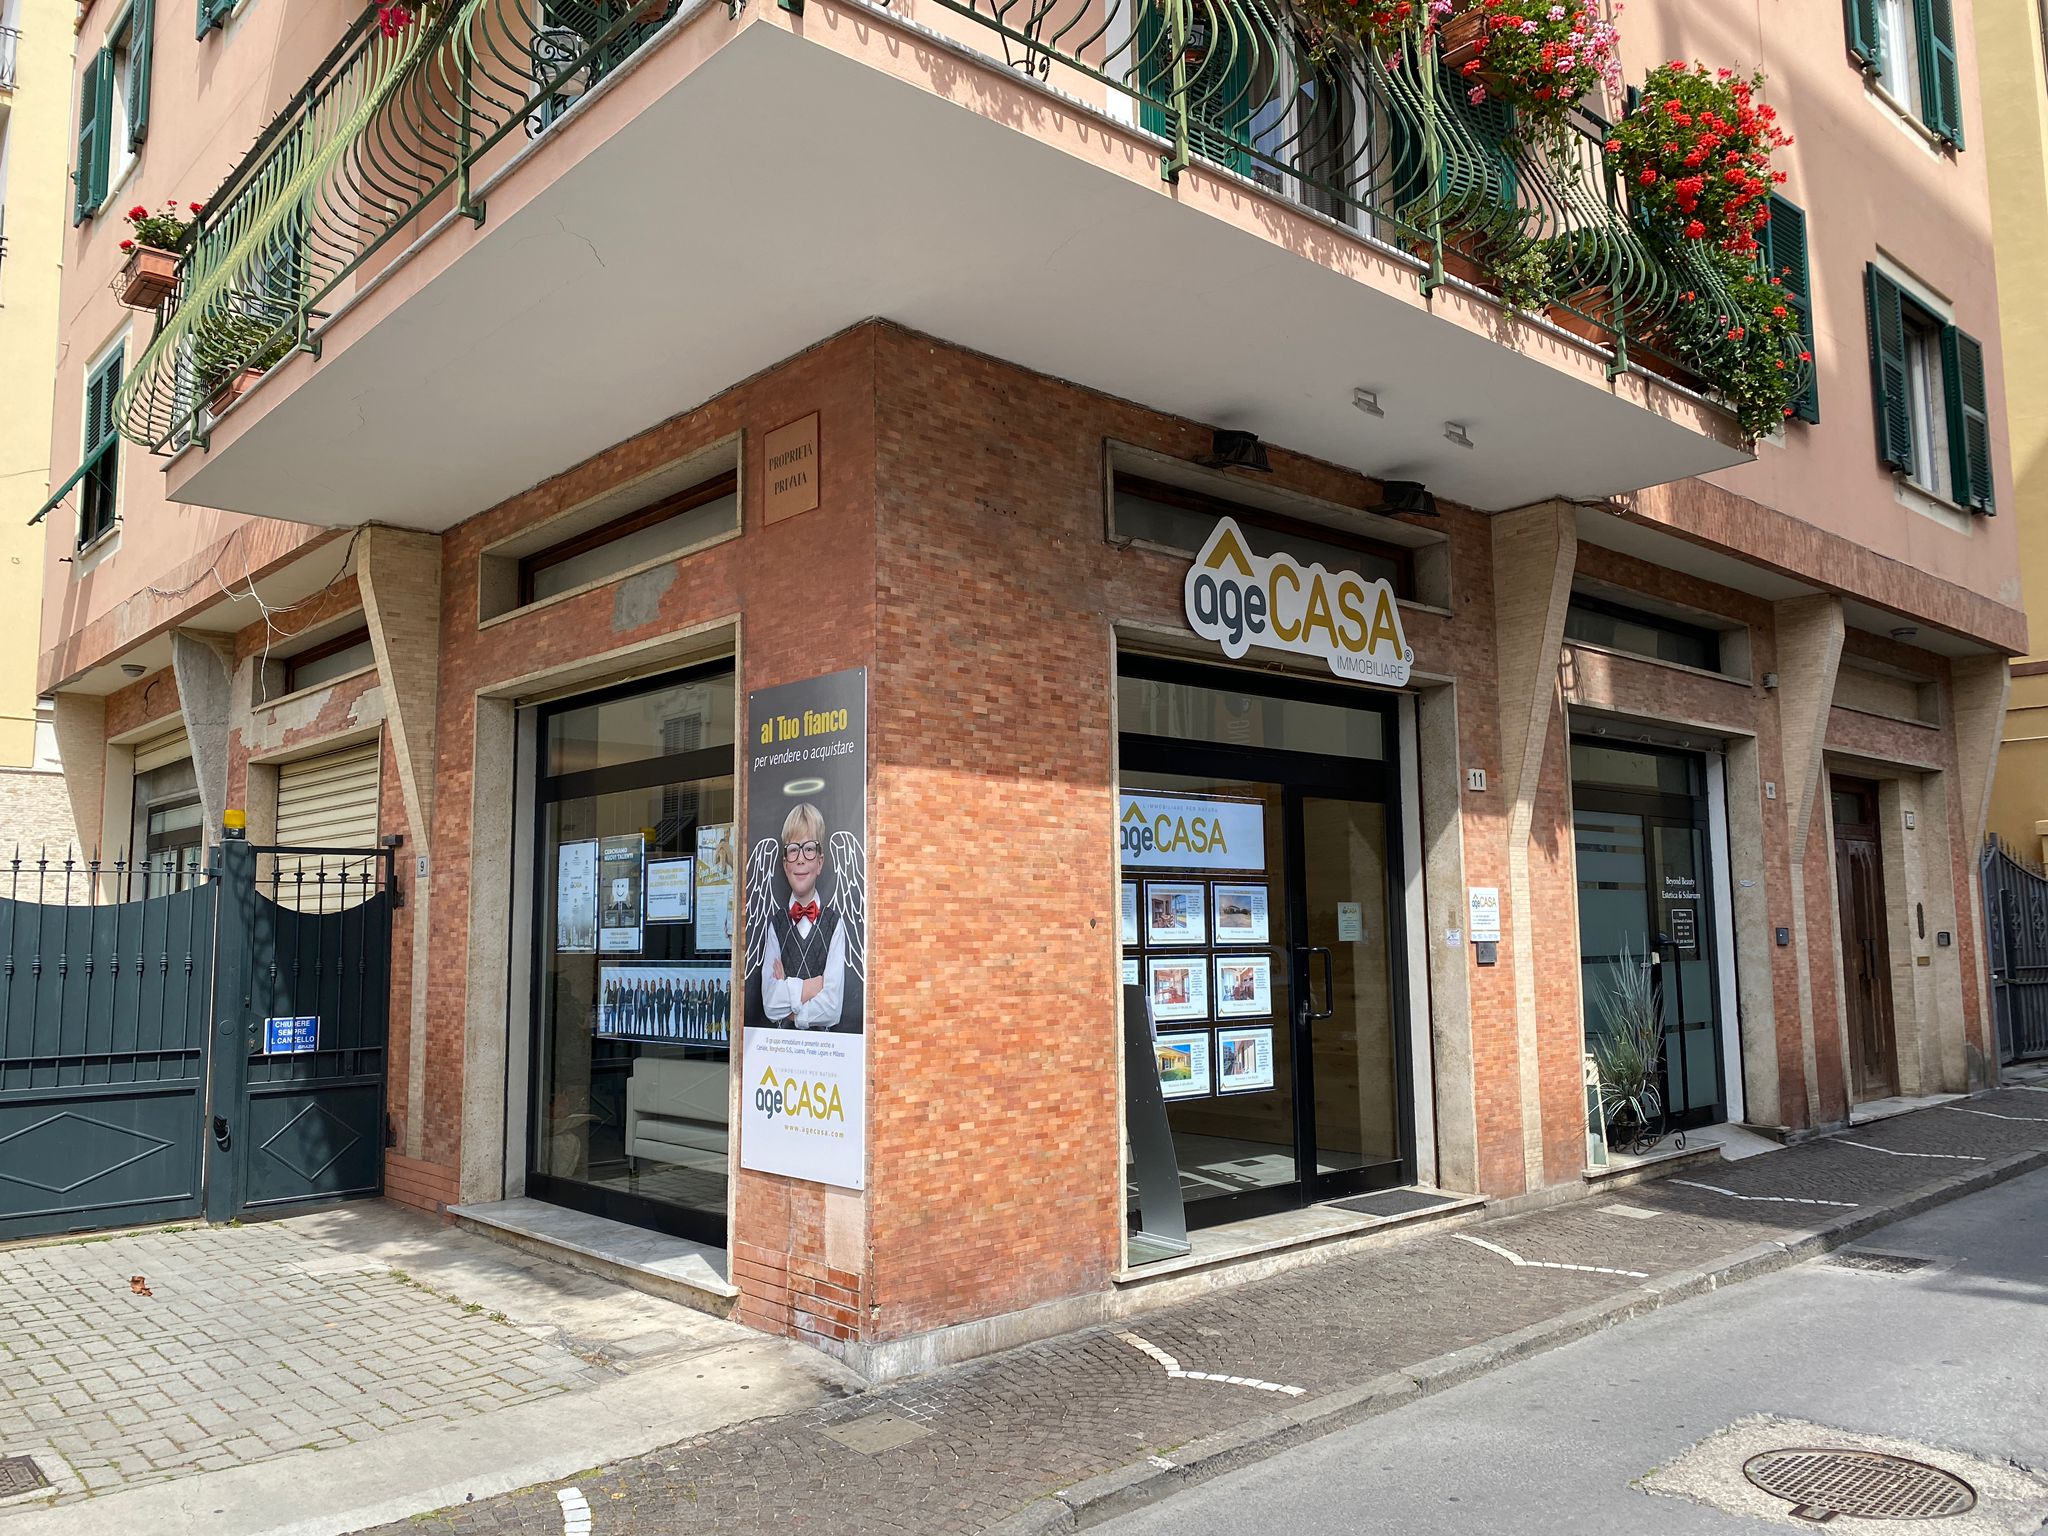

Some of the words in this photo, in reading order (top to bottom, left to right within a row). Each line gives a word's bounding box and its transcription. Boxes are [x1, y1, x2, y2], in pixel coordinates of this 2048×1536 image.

[774, 472, 807, 496] PRIVATA
[1336, 655, 1404, 681] IMMOBILIARE
[760, 718, 773, 744] al
[777, 715, 800, 741] Tuo
[803, 708, 848, 737] fianco
[753, 756, 767, 772] per
[769, 748, 801, 766] vendere
[802, 749, 809, 760] o
[810, 740, 855, 762] acquistare
[1472, 772, 1483, 787] 11
[419, 860, 425, 872] 9
[784, 1124, 845, 1139] www.agecasa.com
